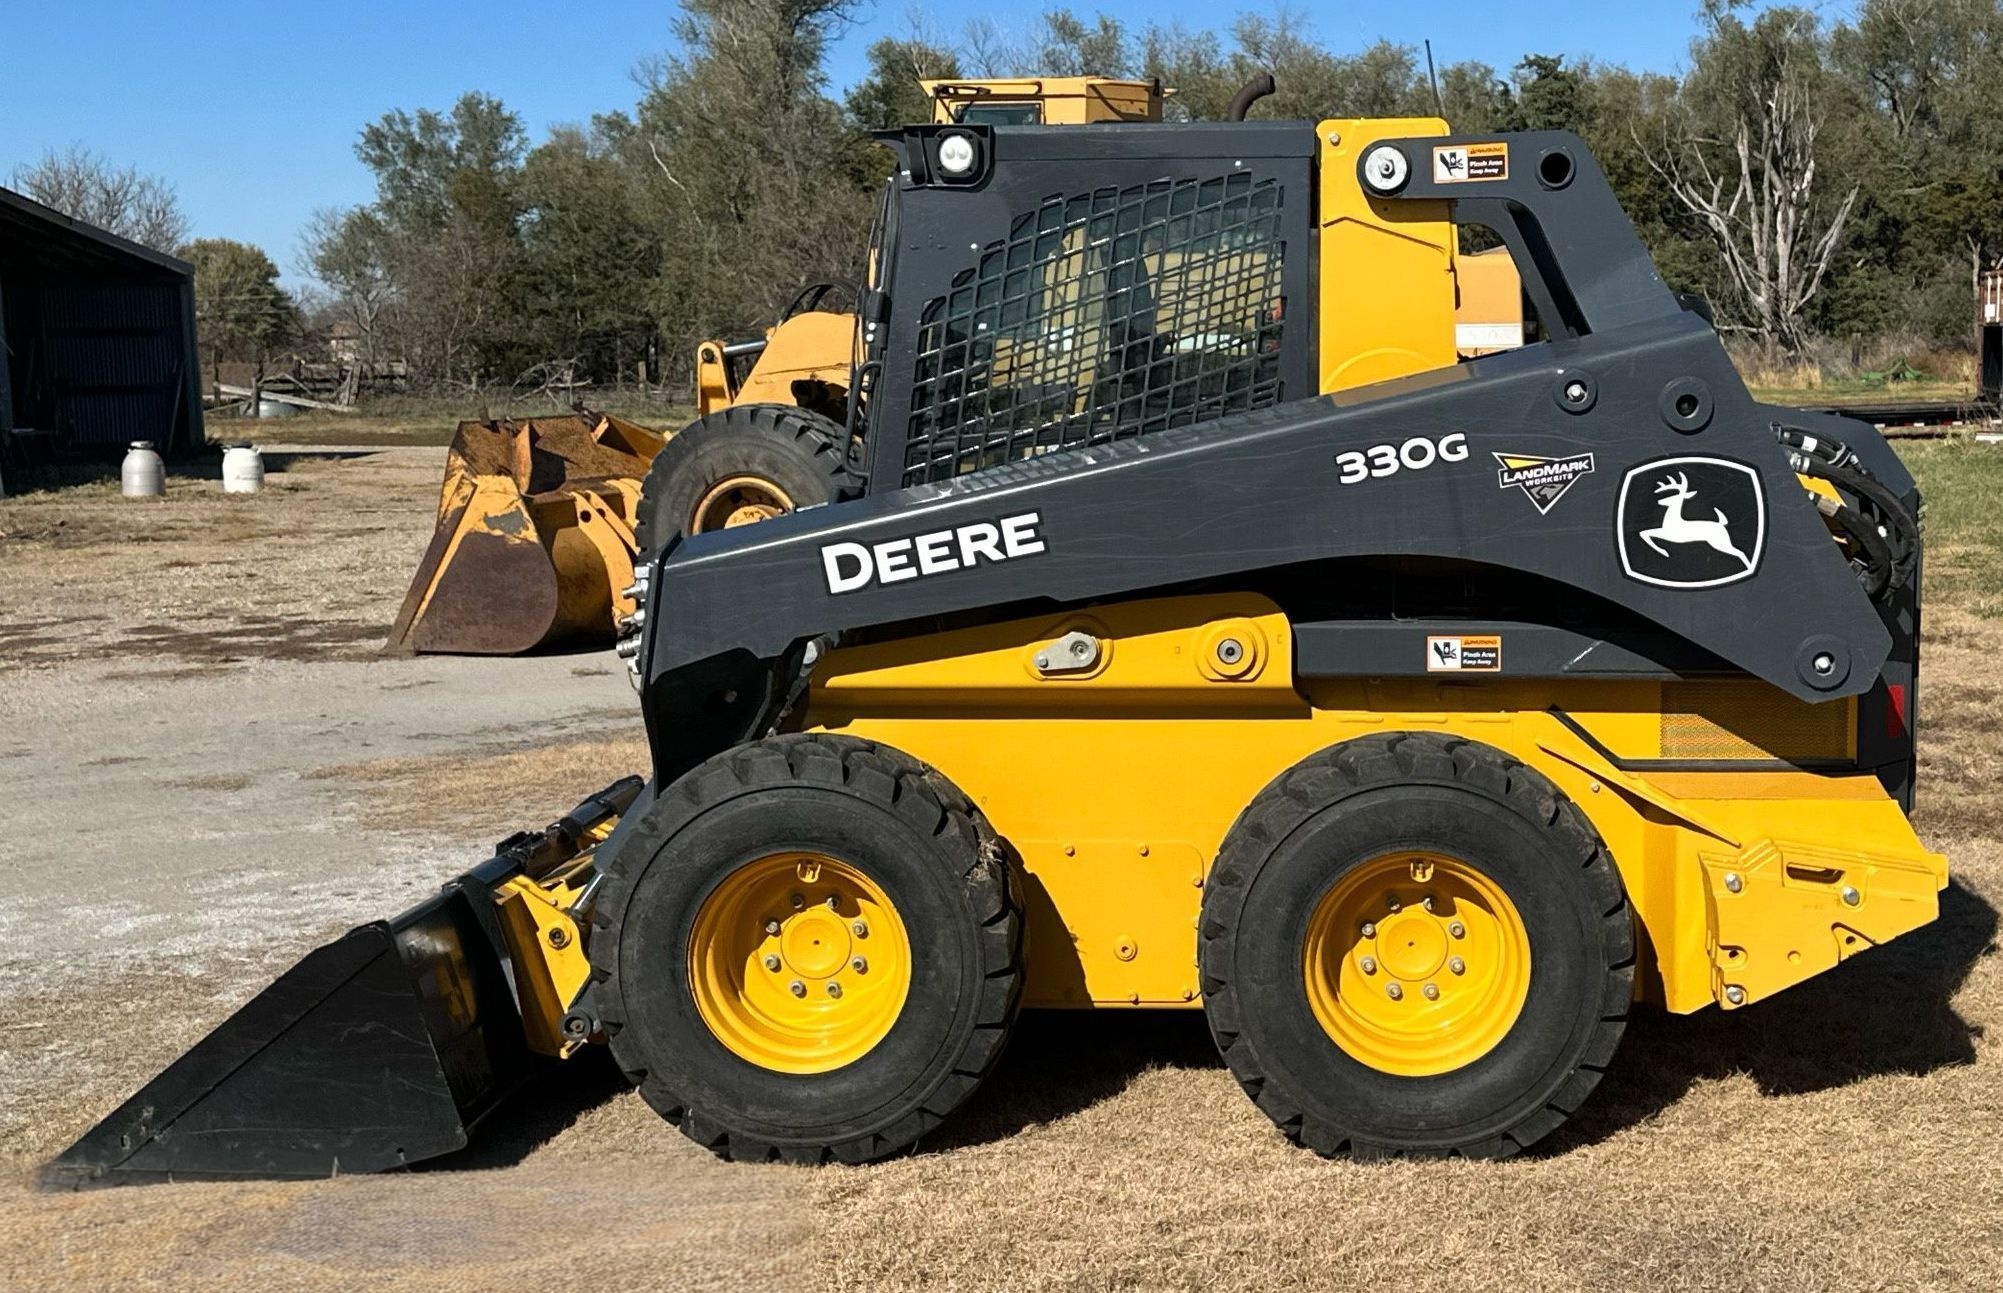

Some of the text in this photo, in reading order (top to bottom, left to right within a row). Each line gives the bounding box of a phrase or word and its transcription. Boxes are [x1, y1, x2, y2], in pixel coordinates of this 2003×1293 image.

[1335, 432, 1469, 484] 330G
[1503, 459, 1589, 483] LANDMARK
[1525, 473, 1573, 487] WORKSITE
[822, 512, 1045, 594] DEERE
